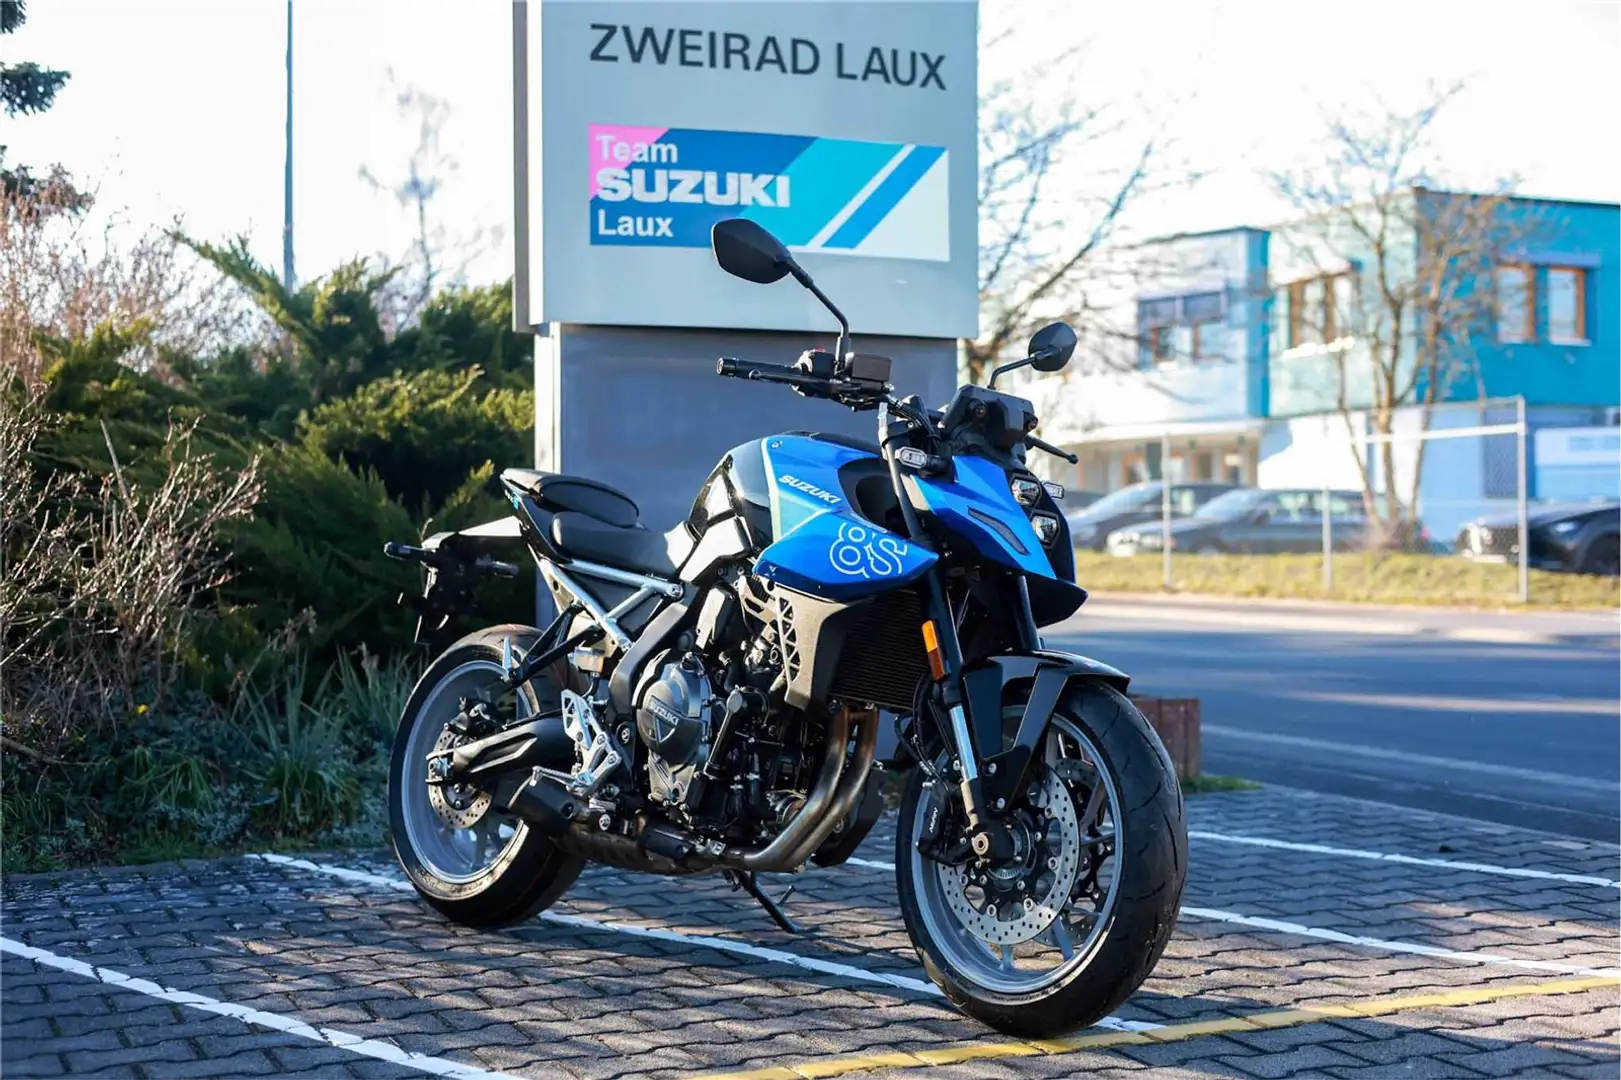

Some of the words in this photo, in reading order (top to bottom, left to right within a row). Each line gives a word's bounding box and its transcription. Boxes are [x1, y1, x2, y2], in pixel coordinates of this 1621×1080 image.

[590, 23, 820, 76] ZWEIRAD
[835, 42, 946, 91] LAUX
[595, 134, 678, 163] Team
[595, 167, 791, 208] SUZUKI
[597, 208, 674, 238] Laux
[779, 474, 841, 504] SUZUKI
[649, 700, 680, 726] SUZUKI
